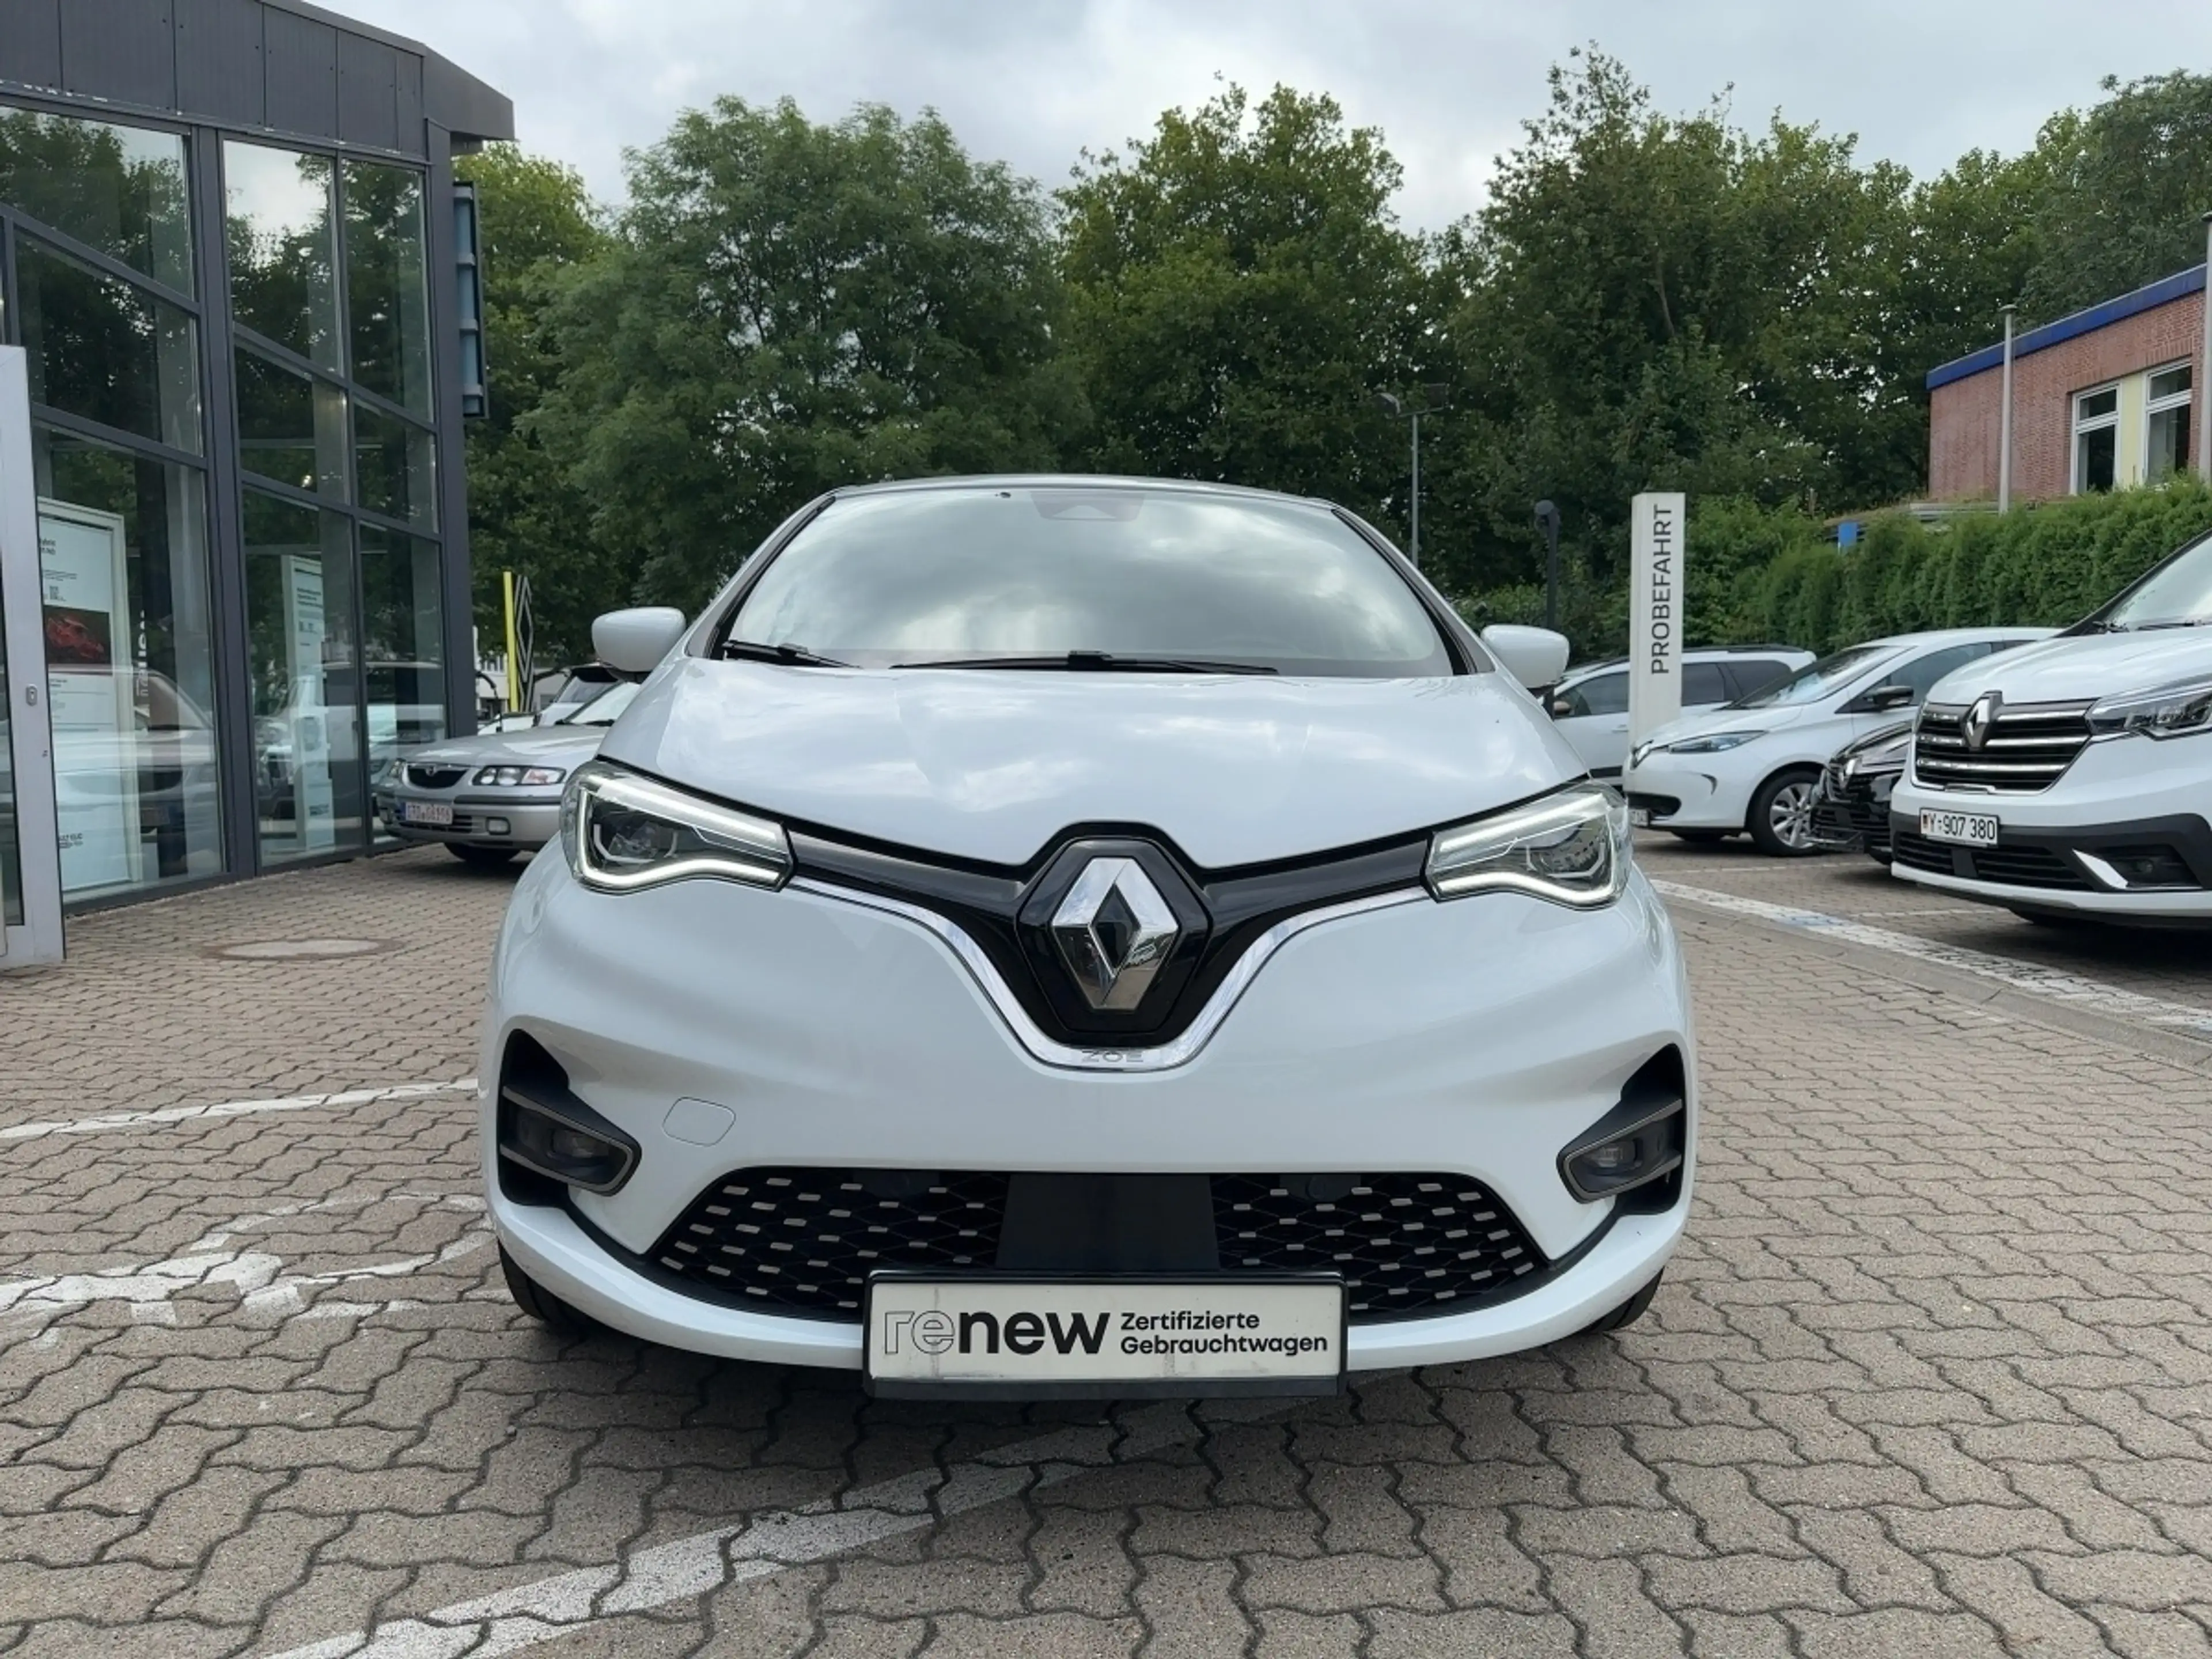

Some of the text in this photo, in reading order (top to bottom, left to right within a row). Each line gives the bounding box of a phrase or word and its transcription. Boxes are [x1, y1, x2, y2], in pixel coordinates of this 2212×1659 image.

[1652, 505, 1672, 674] PROBEFAHRT
[1970, 818, 1995, 839] 380
[1082, 1050, 1143, 1062] ZOE
[1120, 1311, 1260, 1331] Zertifizierte
[884, 1310, 1110, 1354] renew
[1120, 1334, 1328, 1356] Gebrauchtwagen
